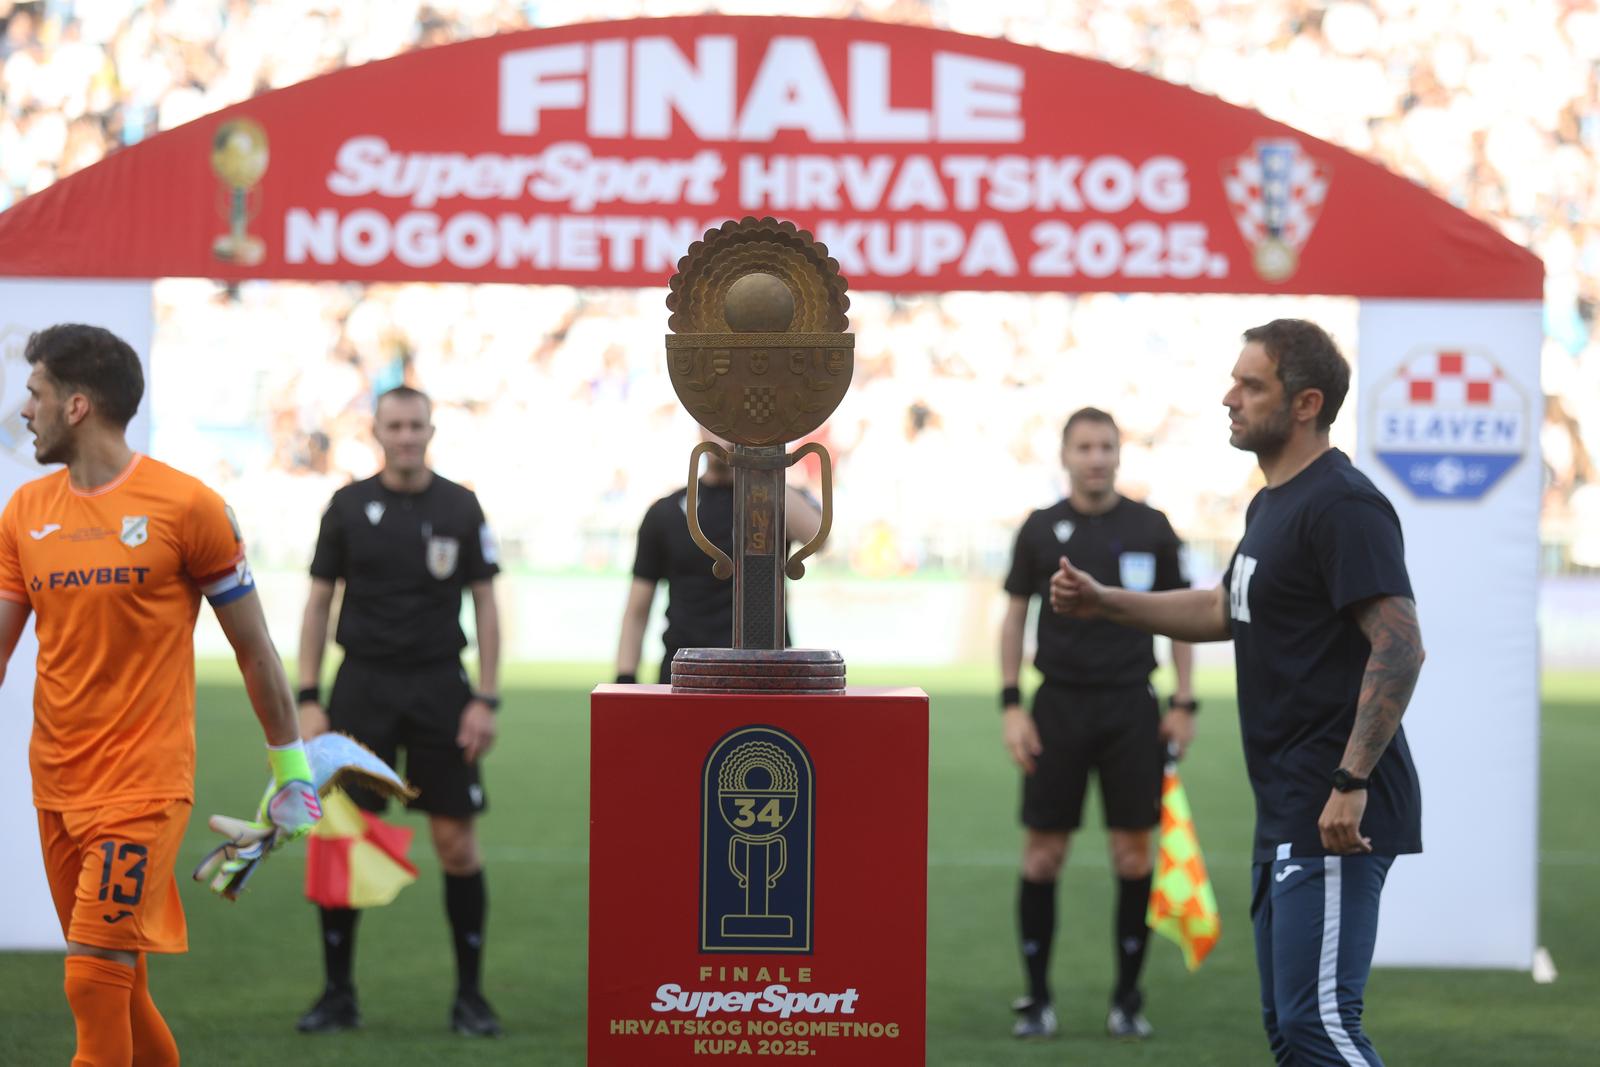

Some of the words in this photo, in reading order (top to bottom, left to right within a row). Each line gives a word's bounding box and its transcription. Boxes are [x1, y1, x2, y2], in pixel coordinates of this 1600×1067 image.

[499, 35, 1025, 142] FINALE
[327, 136, 726, 208] SuperSport
[739, 155, 1190, 213] HRVATSKOG
[816, 220, 1018, 278] KUPA
[1029, 222, 1228, 279] 2025.
[1383, 414, 1519, 442] SLAVEN
[49, 567, 149, 589] FAVBET
[733, 799, 783, 828] 34
[98, 841, 148, 905] 13
[700, 966, 812, 983] FINALE
[651, 984, 859, 1018] SuperSport
[610, 1020, 742, 1036] HRVATSKOG
[747, 1021, 900, 1037] NOGOMETNOG
[694, 1040, 753, 1055] KUPA
[757, 1041, 816, 1056] 2025.
